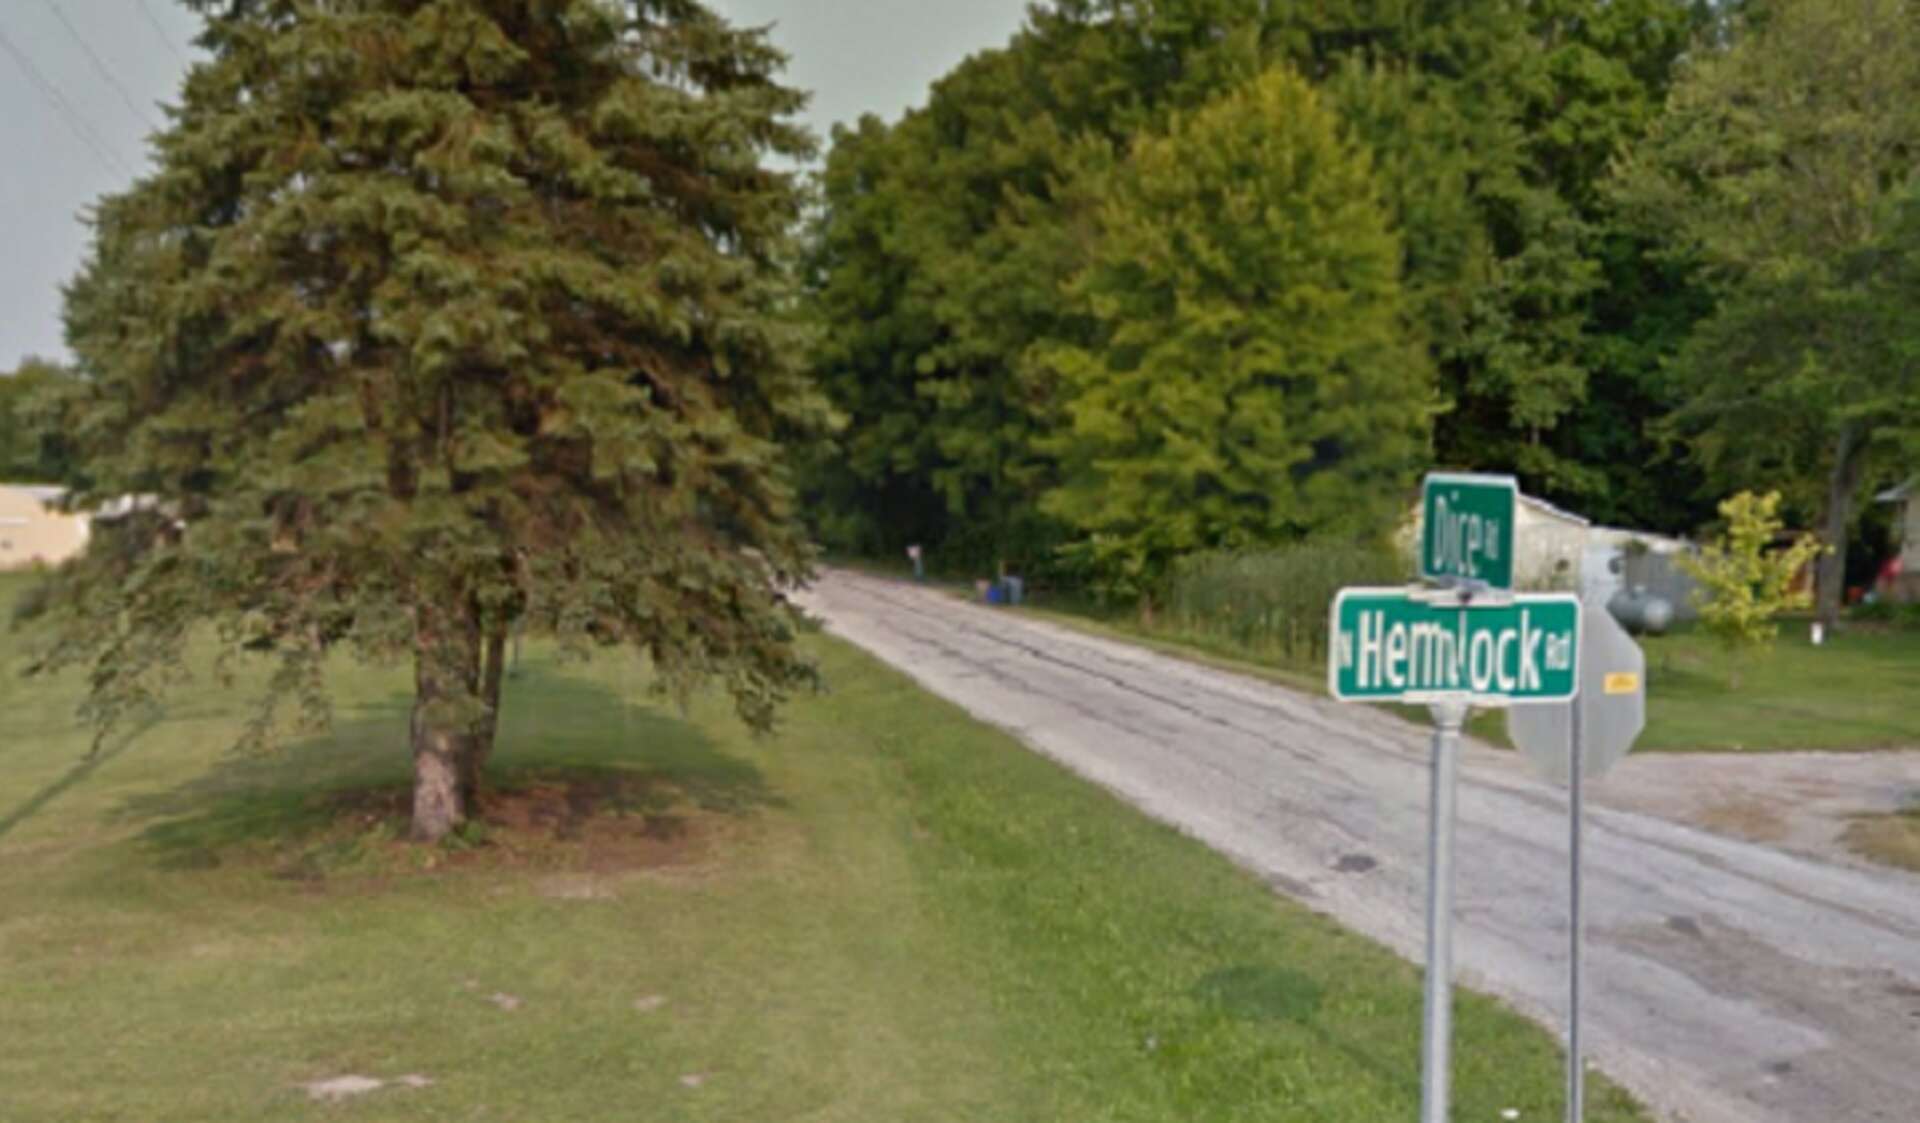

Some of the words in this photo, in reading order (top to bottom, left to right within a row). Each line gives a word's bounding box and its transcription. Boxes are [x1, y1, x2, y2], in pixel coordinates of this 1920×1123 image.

[1433, 490, 1482, 577] Dice
[1357, 608, 1542, 691] Hemlock
[1545, 629, 1571, 670] Rd
